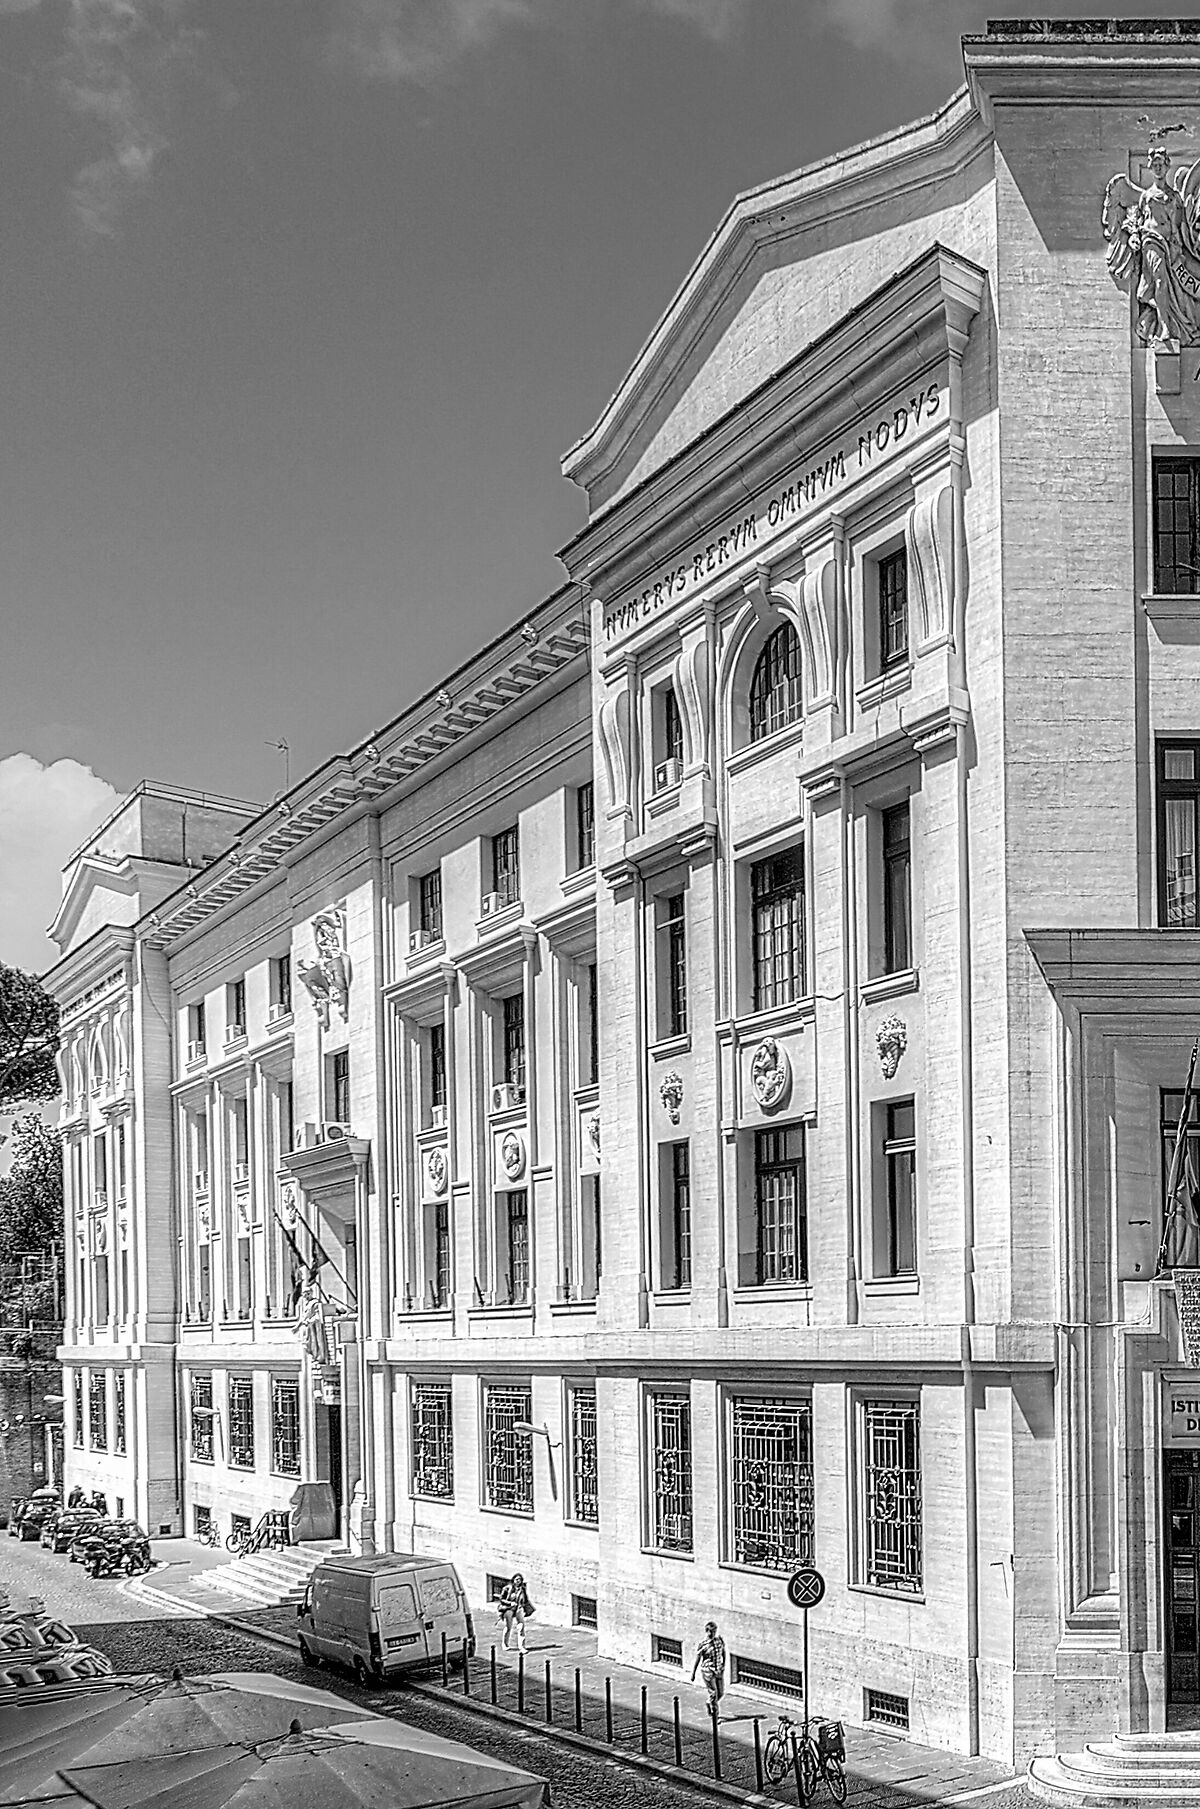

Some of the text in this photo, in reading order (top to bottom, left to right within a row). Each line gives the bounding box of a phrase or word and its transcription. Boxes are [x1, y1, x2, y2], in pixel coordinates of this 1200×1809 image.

[606, 383, 941, 641] NVMERVS RERVM OMNIVM NODVS
